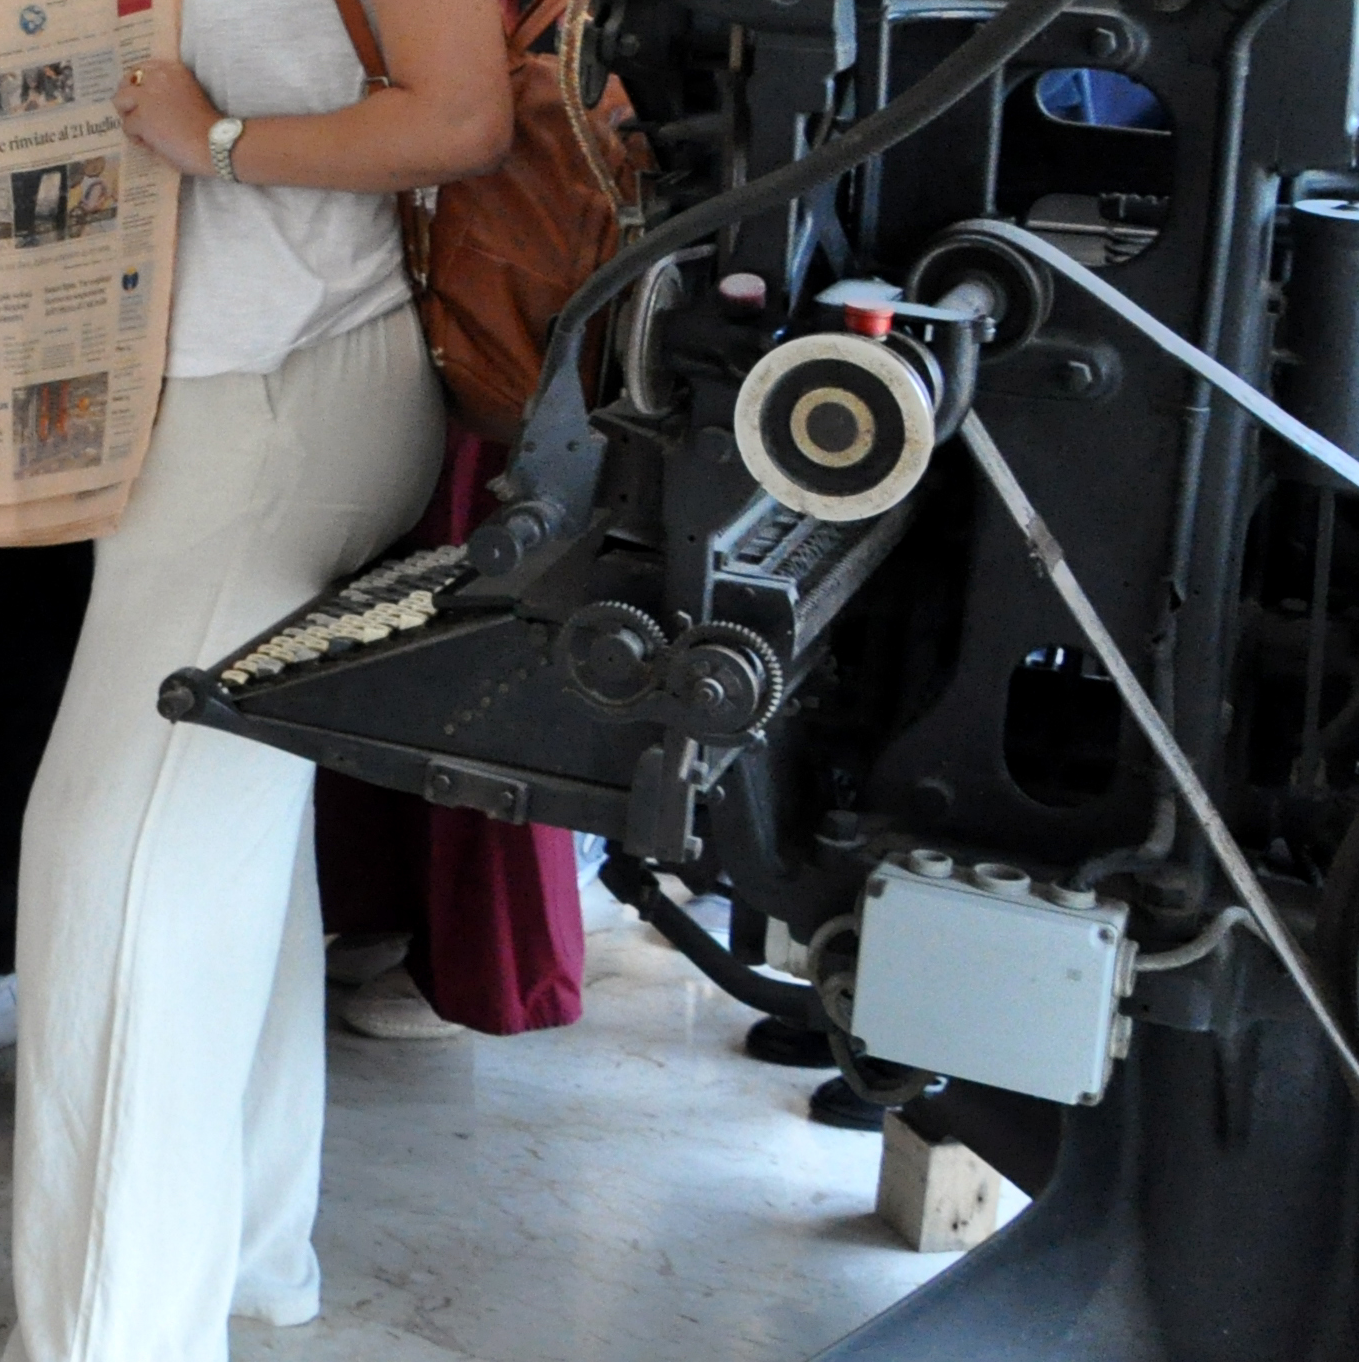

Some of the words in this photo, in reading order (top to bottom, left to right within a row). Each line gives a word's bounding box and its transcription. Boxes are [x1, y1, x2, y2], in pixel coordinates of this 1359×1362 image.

[9, 131, 55, 150] rinviate
[57, 126, 69, 140] al
[70, 123, 83, 139] 21
